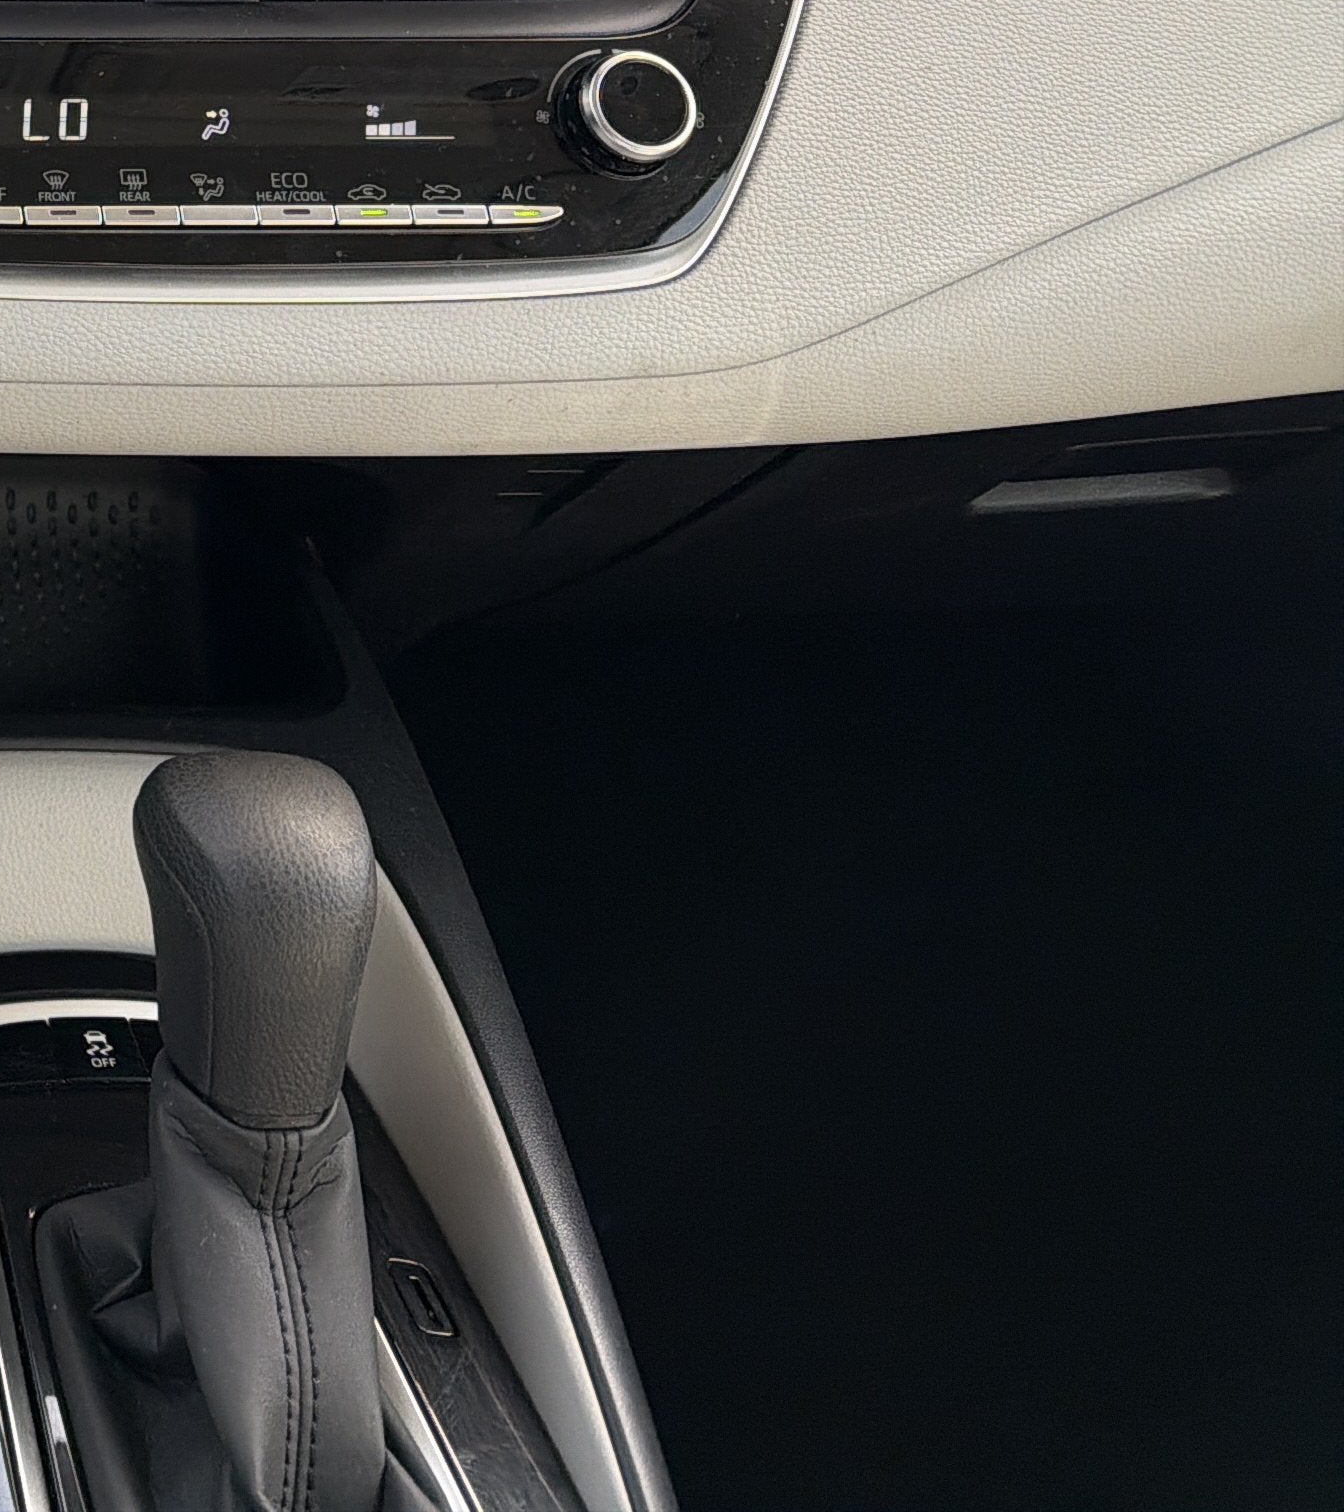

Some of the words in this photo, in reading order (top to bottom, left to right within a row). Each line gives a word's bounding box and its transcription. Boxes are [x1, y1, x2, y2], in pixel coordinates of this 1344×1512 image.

[23, 98, 89, 141] LO
[270, 172, 308, 188] ECO
[38, 192, 77, 203] FRONT
[119, 192, 151, 202] REAR
[256, 190, 327, 202] HEAT/COOL
[502, 186, 537, 201] A/C
[91, 1057, 117, 1069] OFF
